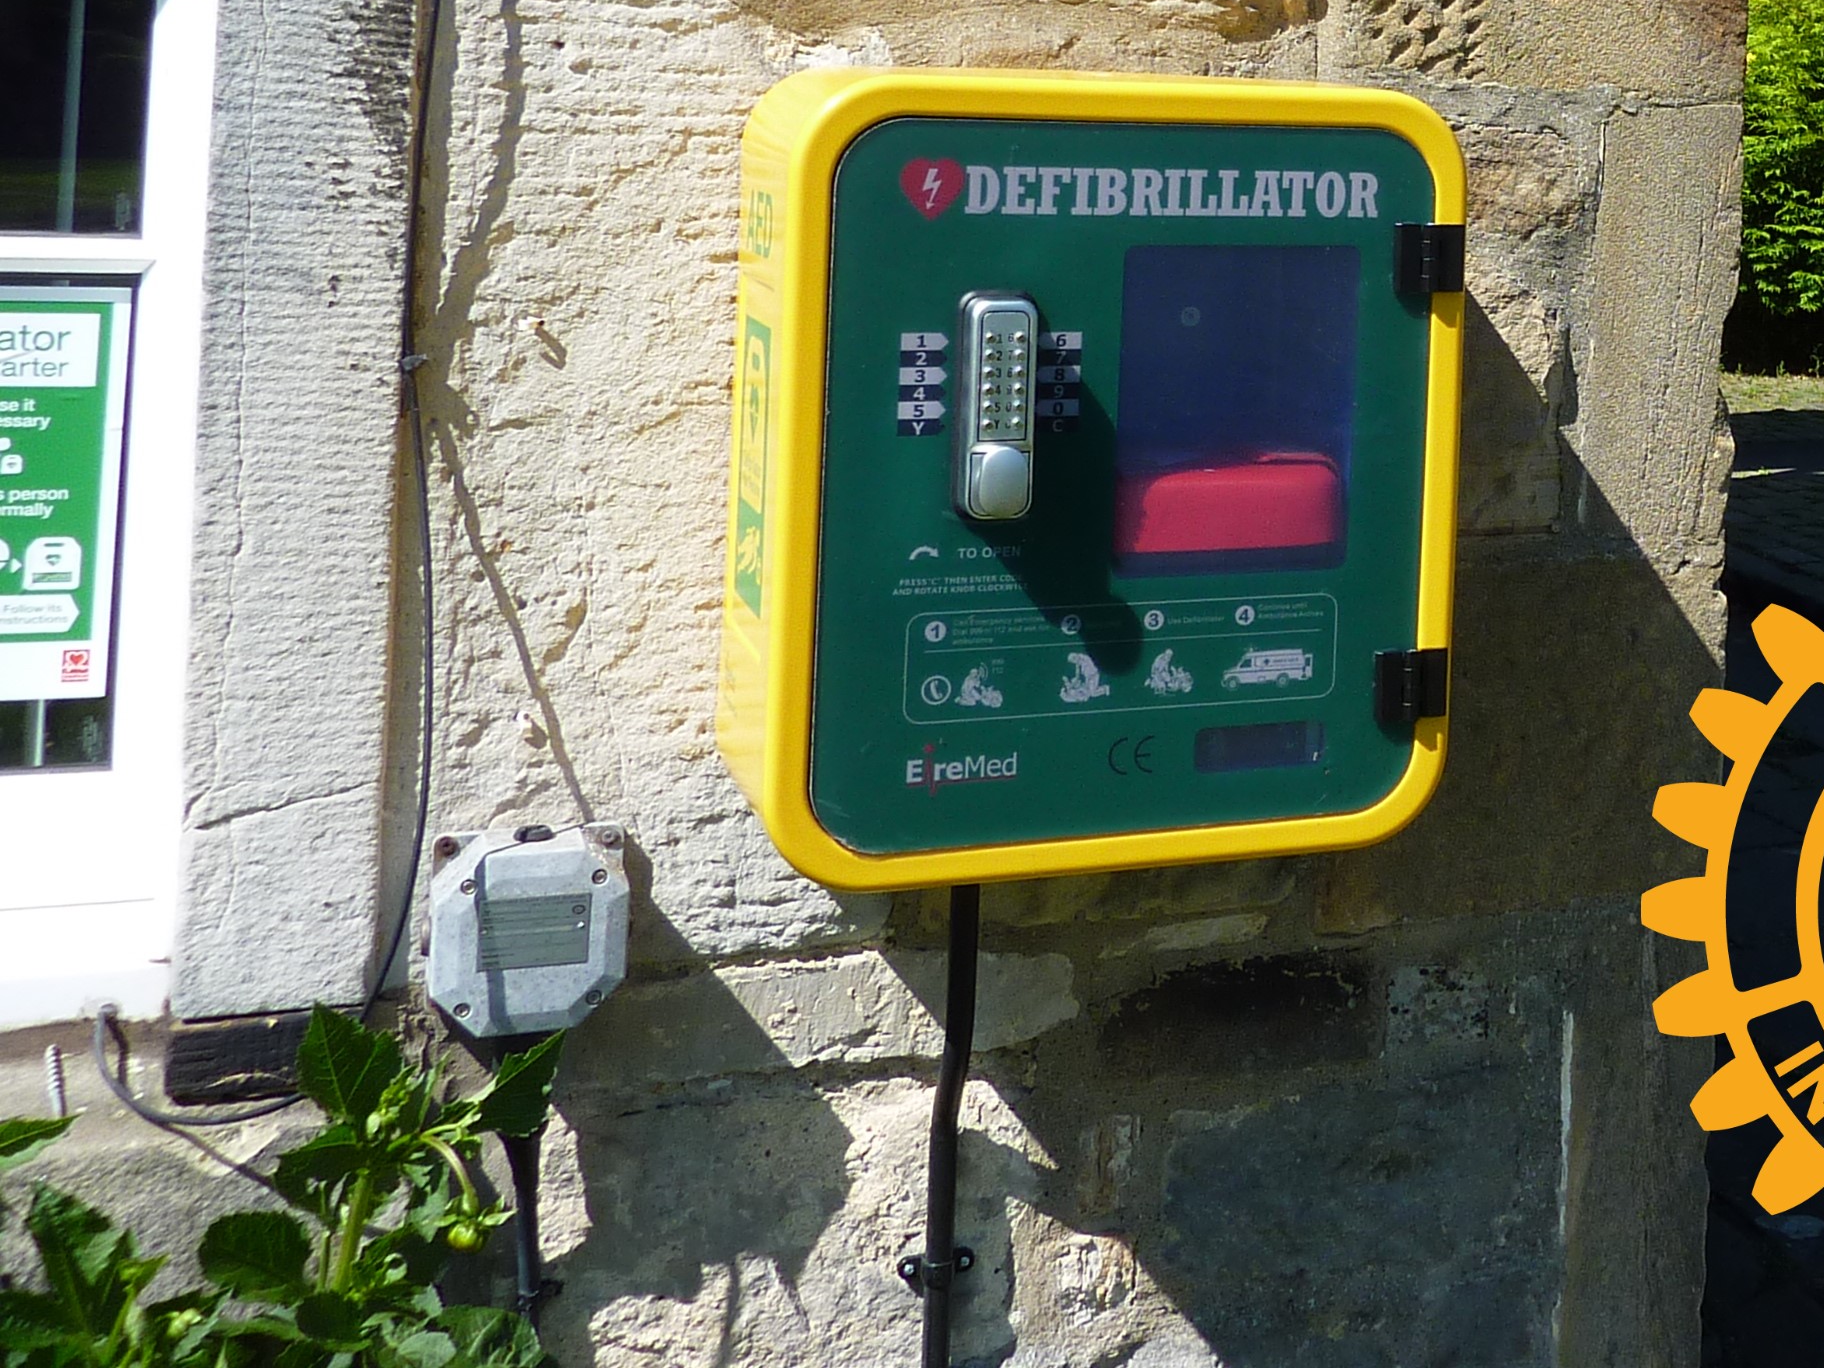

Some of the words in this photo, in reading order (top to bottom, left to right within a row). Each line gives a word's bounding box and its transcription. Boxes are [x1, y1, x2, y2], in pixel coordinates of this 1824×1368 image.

[964, 165, 1378, 218] DEFIBRILLATOR
[747, 189, 773, 259] AED
[917, 335, 927, 348] 1
[1056, 334, 1066, 347] 6
[915, 352, 927, 365] 2
[1056, 351, 1066, 364] 7
[914, 370, 926, 383] 3
[1054, 368, 1065, 381] 8
[913, 387, 926, 400] 4
[1054, 385, 1064, 398] 9
[23, 398, 35, 411] it
[1053, 402, 1063, 415] 0
[913, 405, 925, 418] 5
[912, 422, 925, 435] Y
[1053, 419, 1063, 432] C
[8, 489, 69, 504] person
[958, 547, 978, 559] TO
[982, 546, 1021, 559] OPEN
[944, 576, 968, 585] THEN
[969, 575, 997, 584] ENTER
[892, 587, 912, 596] AND
[914, 586, 948, 595] ROTATE
[950, 585, 976, 593] KNOB
[3, 604, 45, 614] Follow
[47, 604, 63, 613] its
[1239, 608, 1249, 623] 4
[1066, 617, 1076, 631] 2
[1149, 613, 1159, 627] 3
[931, 626, 940, 639] 1
[906, 745, 1017, 792] EireMed
